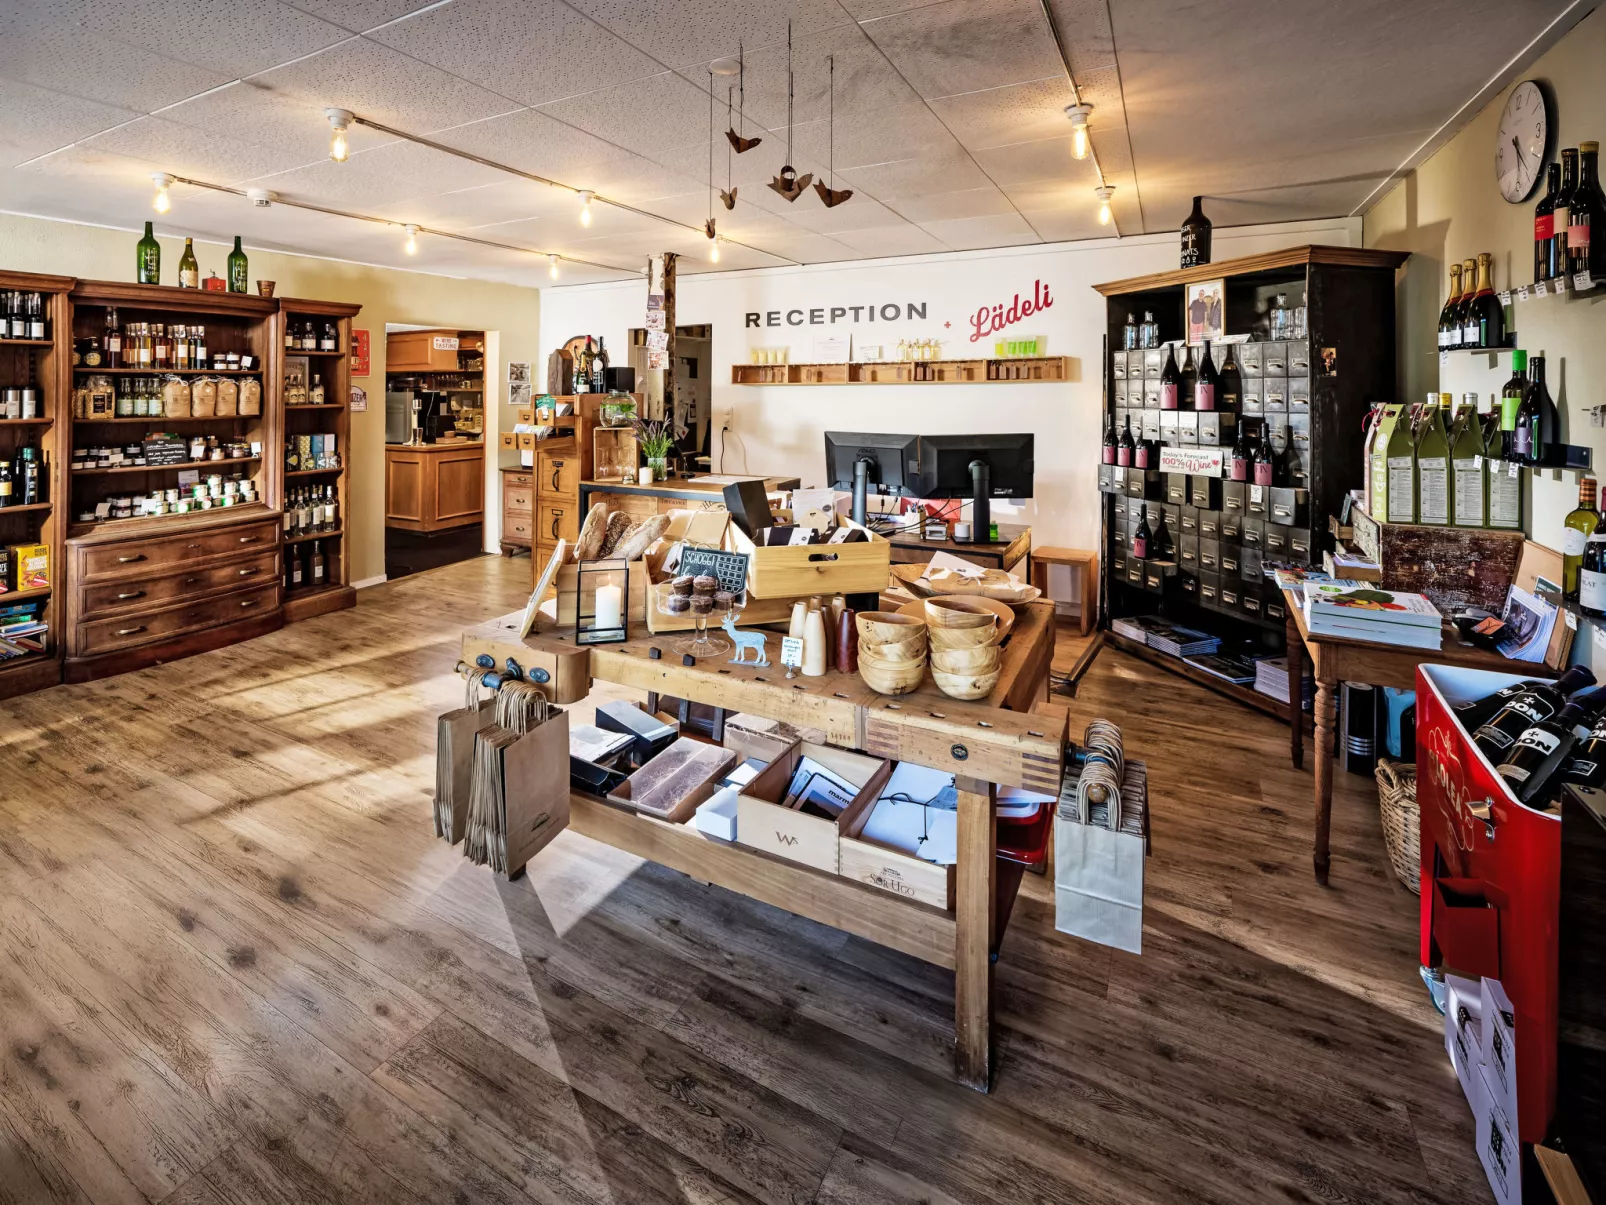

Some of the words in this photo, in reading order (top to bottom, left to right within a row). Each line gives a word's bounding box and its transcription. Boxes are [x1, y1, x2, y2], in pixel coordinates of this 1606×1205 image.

[1535, 122, 1541, 139] 3
[745, 302, 928, 329] RECEPTION
[969, 279, 1054, 343] Lädeli
[1162, 457, 1185, 467] 100%
[685, 552, 715, 566] SCHOGGI
[1516, 736, 1552, 753] ON
[828, 788, 850, 805] marm
